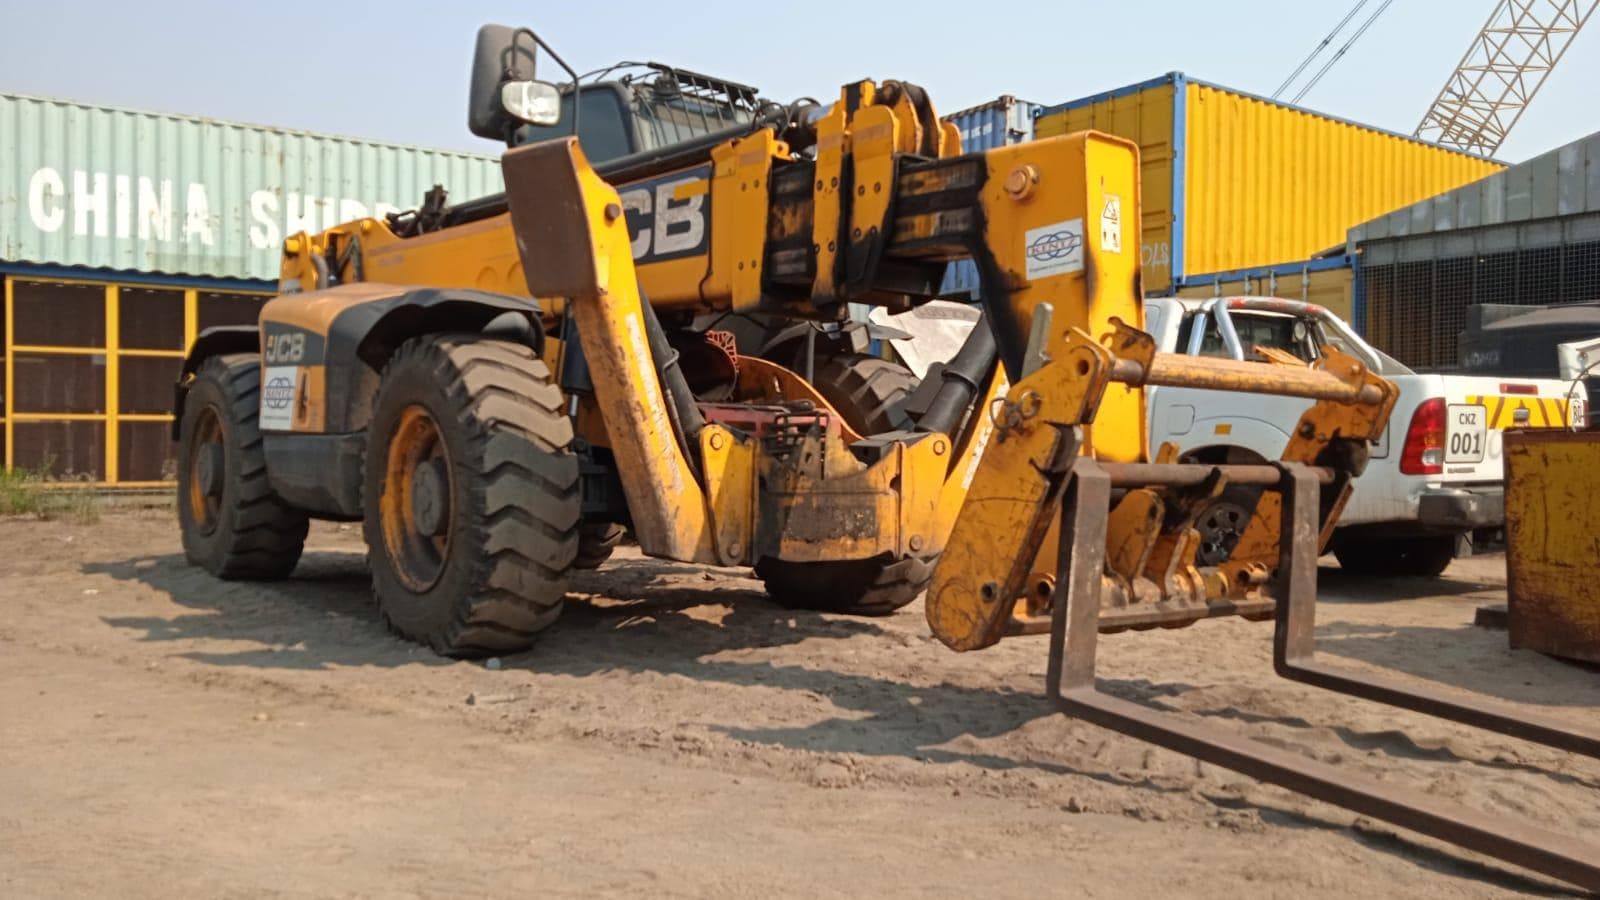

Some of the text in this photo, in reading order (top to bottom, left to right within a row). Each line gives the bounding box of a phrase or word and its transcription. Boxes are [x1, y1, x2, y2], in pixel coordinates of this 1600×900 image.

[29, 167, 417, 248] CHINA SHI
[266, 333, 306, 362] JCB
[1459, 413, 1476, 425] CKZ
[1451, 432, 1480, 454] 001
